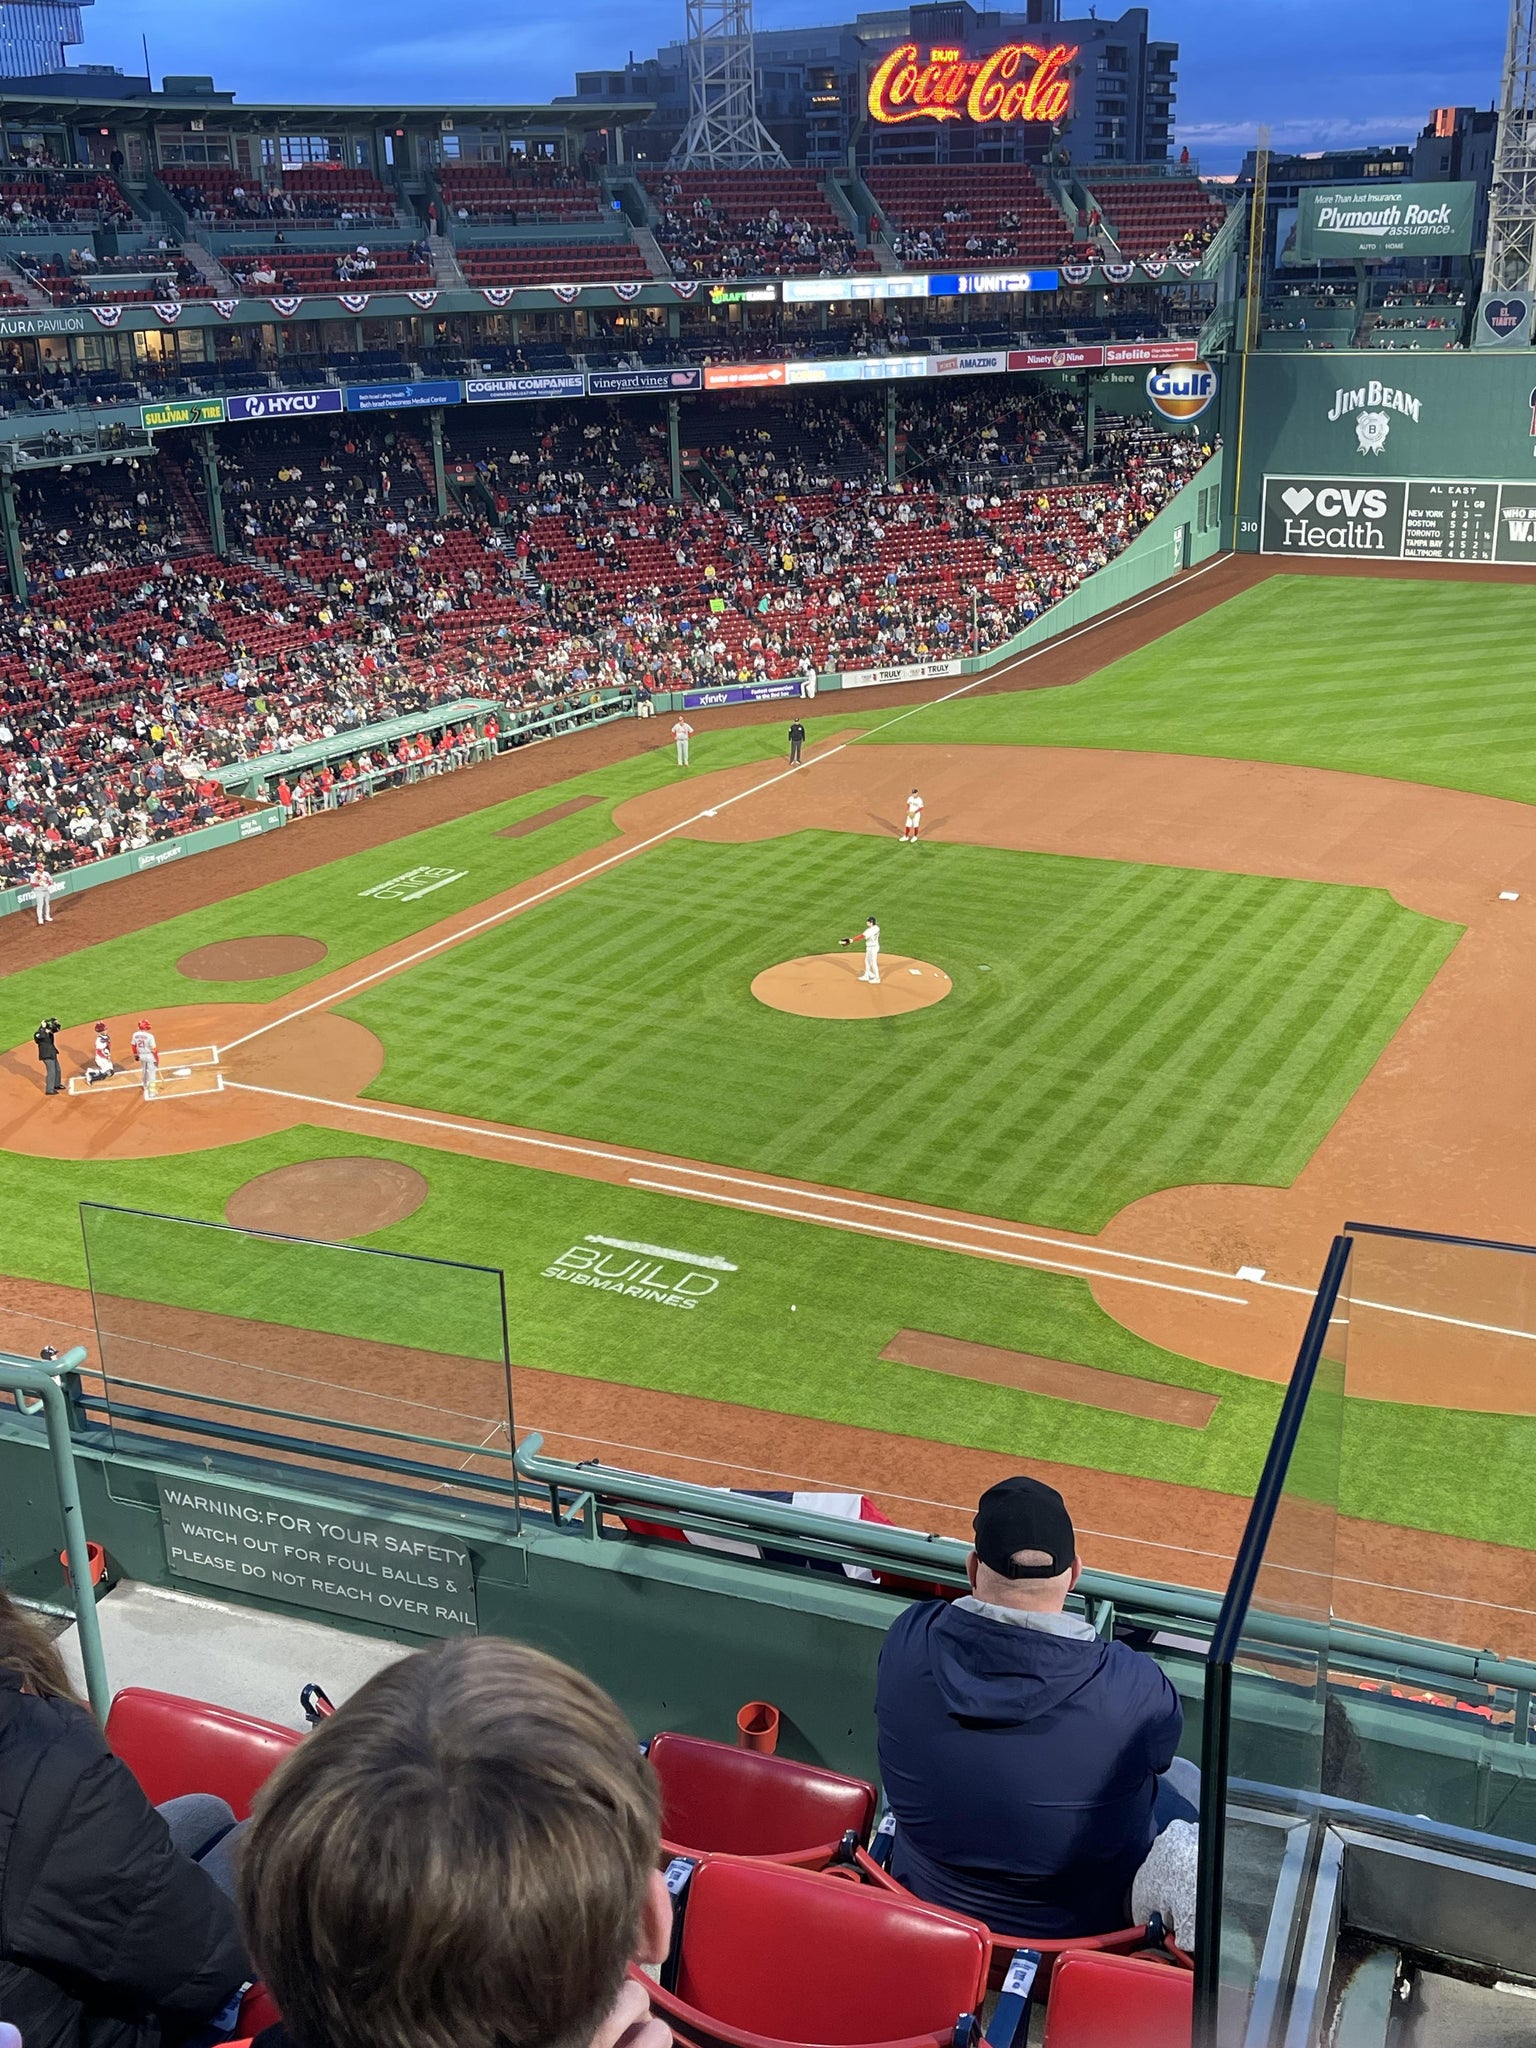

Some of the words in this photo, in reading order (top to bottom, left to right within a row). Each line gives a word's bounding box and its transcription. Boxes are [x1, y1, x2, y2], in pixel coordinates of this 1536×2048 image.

[930, 48, 960, 62] ENJOY
[868, 43, 1079, 123] Coca-Cola
[1314, 195, 1333, 204] More
[1334, 194, 1352, 204] Than
[1352, 193, 1367, 203] Just
[1318, 205, 1401, 229] Plymouth
[1404, 204, 1451, 225] Rock
[1385, 242, 1404, 250] HOME
[974, 274, 1030, 292] UNITED
[1500, 307, 1510, 317] EL
[37, 319, 84, 332] PAVILION
[1027, 355, 1052, 365] Ninety
[1066, 353, 1085, 363] Nine
[1106, 350, 1150, 361] Safelite
[959, 358, 997, 369] AMAZING
[593, 376, 639, 390] vineyard
[640, 376, 667, 386] vines
[1111, 373, 1135, 382] here
[469, 381, 517, 393] COGHLIN
[518, 378, 582, 390] COMPANIES
[1150, 373, 1211, 396] Gulf
[268, 397, 318, 412] HYCU
[412, 397, 430, 405] Medical
[1327, 388, 1365, 422] JIM
[1367, 381, 1420, 423] BEAM
[145, 409, 189, 425] SULLIVAN
[201, 406, 221, 419] TIRE
[1430, 486, 1443, 494] AL
[1448, 487, 1477, 495] EAST
[1315, 488, 1387, 518] CVS
[1452, 500, 1458, 508] W
[1464, 500, 1470, 508] L
[1408, 509, 1423, 518] NEW
[1425, 510, 1444, 519] YORK
[1451, 511, 1457, 519] 6
[1463, 511, 1469, 519] 3
[1502, 509, 1526, 519] WHO
[1528, 509, 1536, 519] B
[1241, 522, 1257, 532] 310
[1407, 520, 1436, 528] BOSTON
[1450, 521, 1456, 529] 5
[1462, 521, 1468, 529] 4
[1283, 519, 1384, 549] Health
[1407, 529, 1440, 538] TORONTO
[1449, 530, 1455, 539] 5
[1461, 531, 1467, 539] 5
[1406, 539, 1428, 547] TAMPA
[1429, 540, 1443, 548] BAY
[1448, 540, 1454, 549] 4
[1461, 541, 1466, 549] 5
[1473, 541, 1479, 549] 2
[1405, 548, 1442, 557] BALTIMORE
[1448, 550, 1454, 558] 4
[1460, 550, 1465, 558] 6
[1472, 550, 1478, 558] 2
[880, 670, 901, 679] TRULY
[928, 664, 949, 673] TRULY
[699, 693, 727, 706] xfinity
[156, 846, 182, 864] TICKET
[553, 1245, 719, 1296] BUILD
[540, 1266, 698, 1310] SUBMARINES
[164, 1489, 264, 1524] WARNING:
[267, 1511, 311, 1534] FOR
[316, 1521, 378, 1548] YOUR
[385, 1536, 466, 1566] SAFETY
[181, 1522, 237, 1545] WATCH
[243, 1537, 279, 1555] OUT
[284, 1545, 321, 1564] FOR
[327, 1555, 376, 1576] FOUL
[381, 1566, 439, 1590] BALLS
[445, 1580, 458, 1593] &
[171, 1546, 237, 1573] PLEASE
[241, 1563, 266, 1579] DO
[271, 1570, 306, 1588] NOT
[311, 1580, 372, 1603] REACH
[378, 1594, 429, 1616] OVER
[435, 1606, 476, 1626] RAIL
